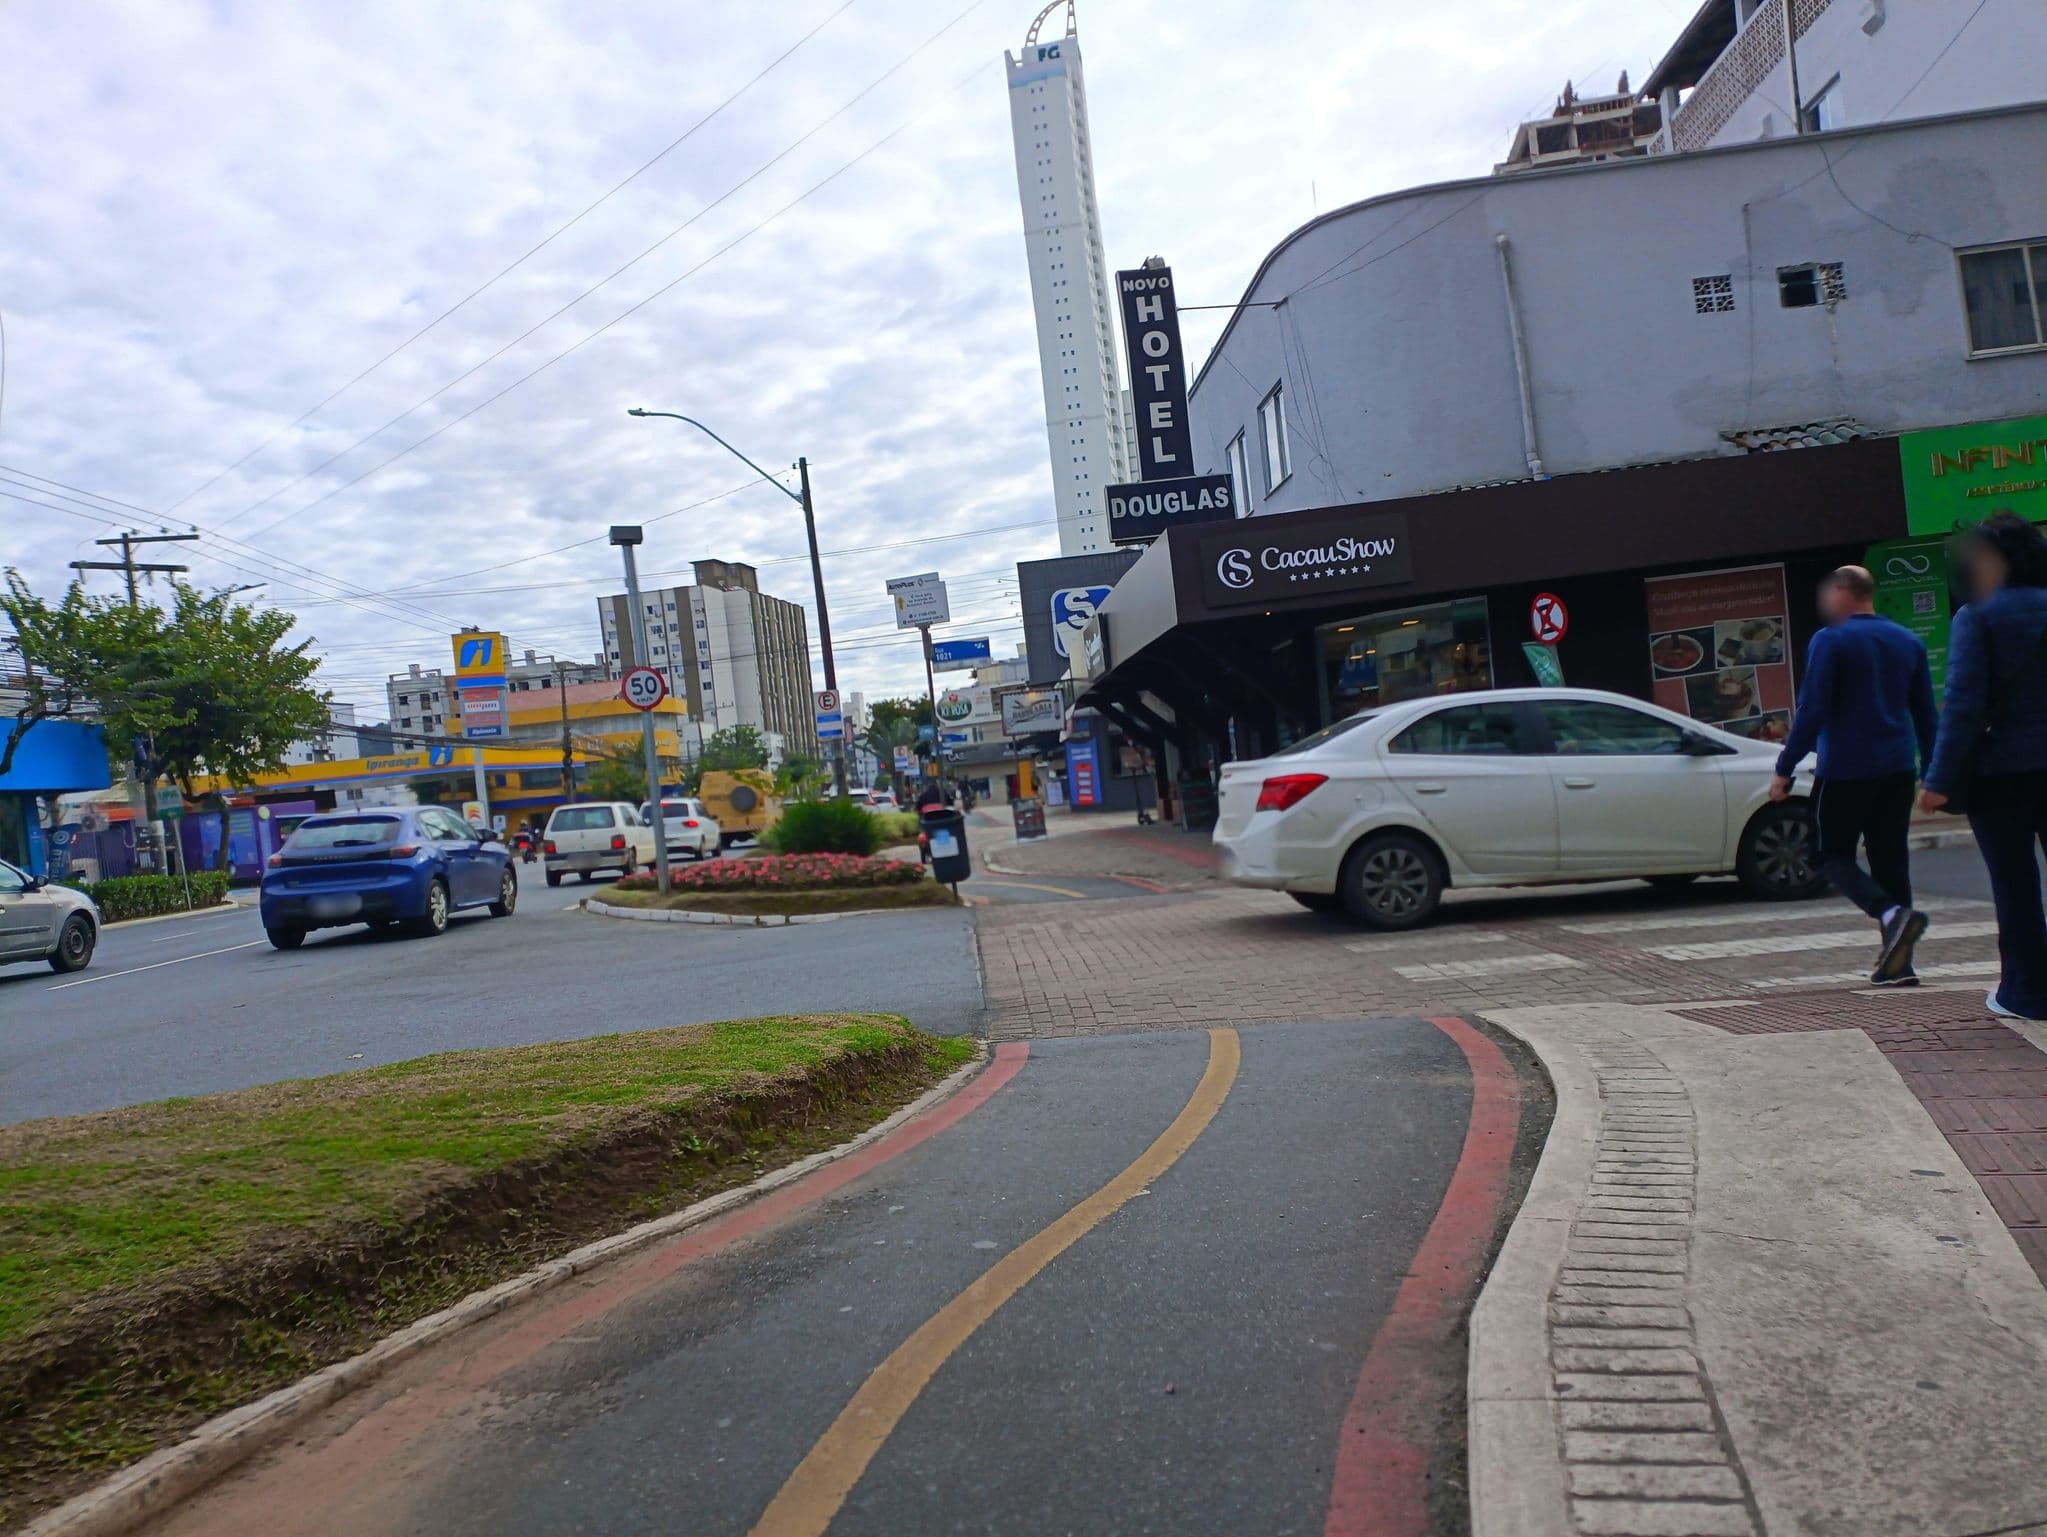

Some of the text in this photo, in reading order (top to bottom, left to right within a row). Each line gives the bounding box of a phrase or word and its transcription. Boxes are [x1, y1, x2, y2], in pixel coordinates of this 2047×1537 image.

[1038, 44, 1060, 62] FG
[1122, 277, 1171, 292] NOVO
[1136, 295, 1177, 464] HOTEL
[1111, 487, 1230, 519] DOUGLAS
[936, 652, 952, 662] 1021
[630, 676, 657, 696] 50
[822, 694, 832, 708] E
[366, 757, 420, 772] Ipiranga
